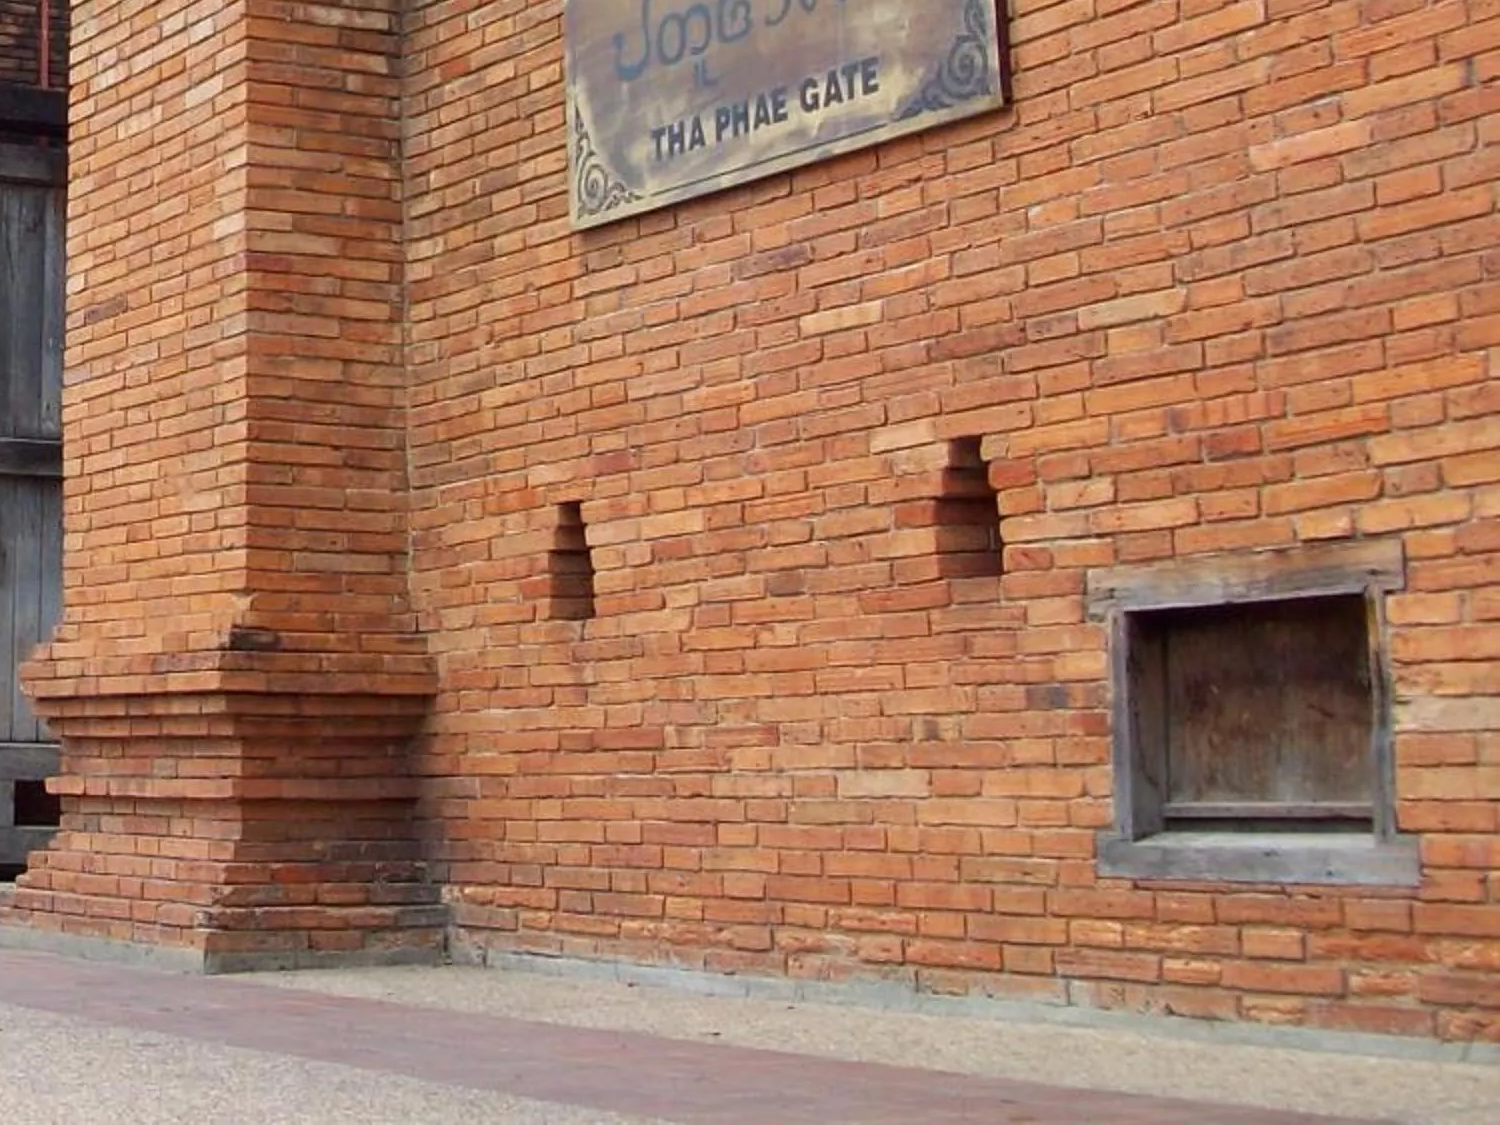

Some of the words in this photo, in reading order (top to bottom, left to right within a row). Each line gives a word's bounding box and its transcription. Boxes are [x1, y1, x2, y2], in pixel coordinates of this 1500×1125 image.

[651, 115, 706, 162] THA
[713, 85, 789, 143] PHAE
[799, 56, 880, 113] GATE
